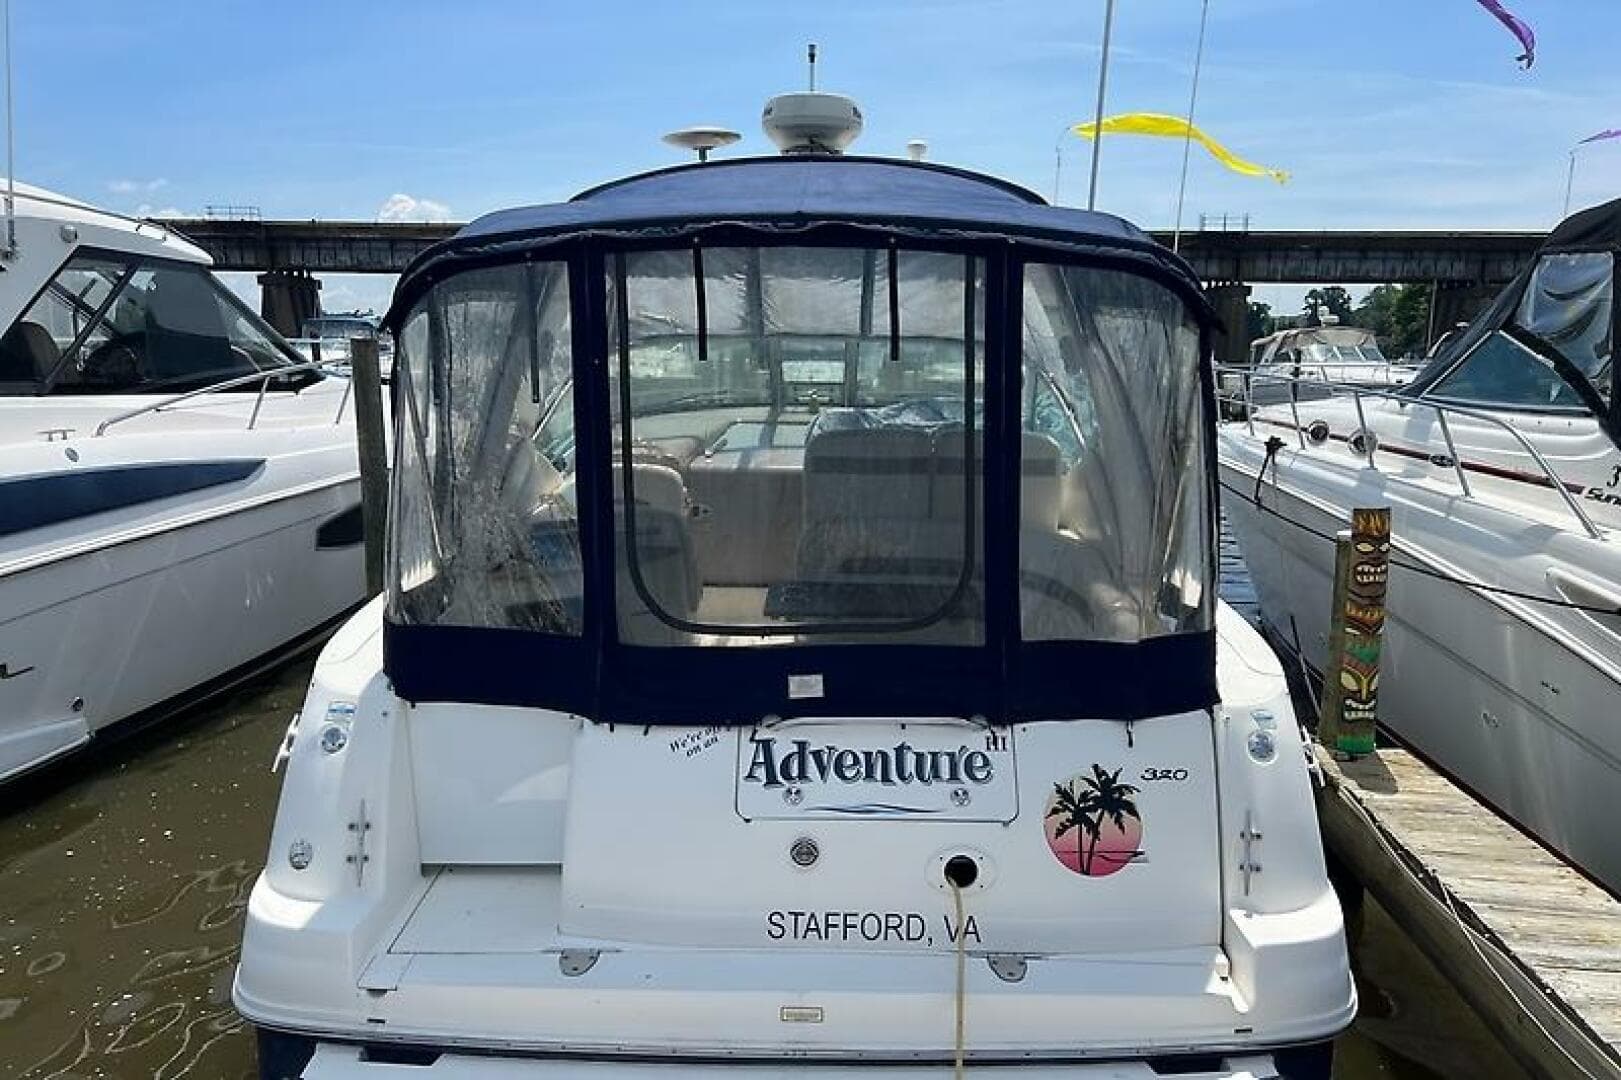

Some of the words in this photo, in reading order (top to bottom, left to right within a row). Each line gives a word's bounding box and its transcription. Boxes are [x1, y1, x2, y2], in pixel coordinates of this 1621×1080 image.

[745, 738, 993, 787] Adventure
[1140, 767, 1189, 781] 320
[767, 911, 933, 947] STAFFORD,
[943, 914, 981, 943] VA
